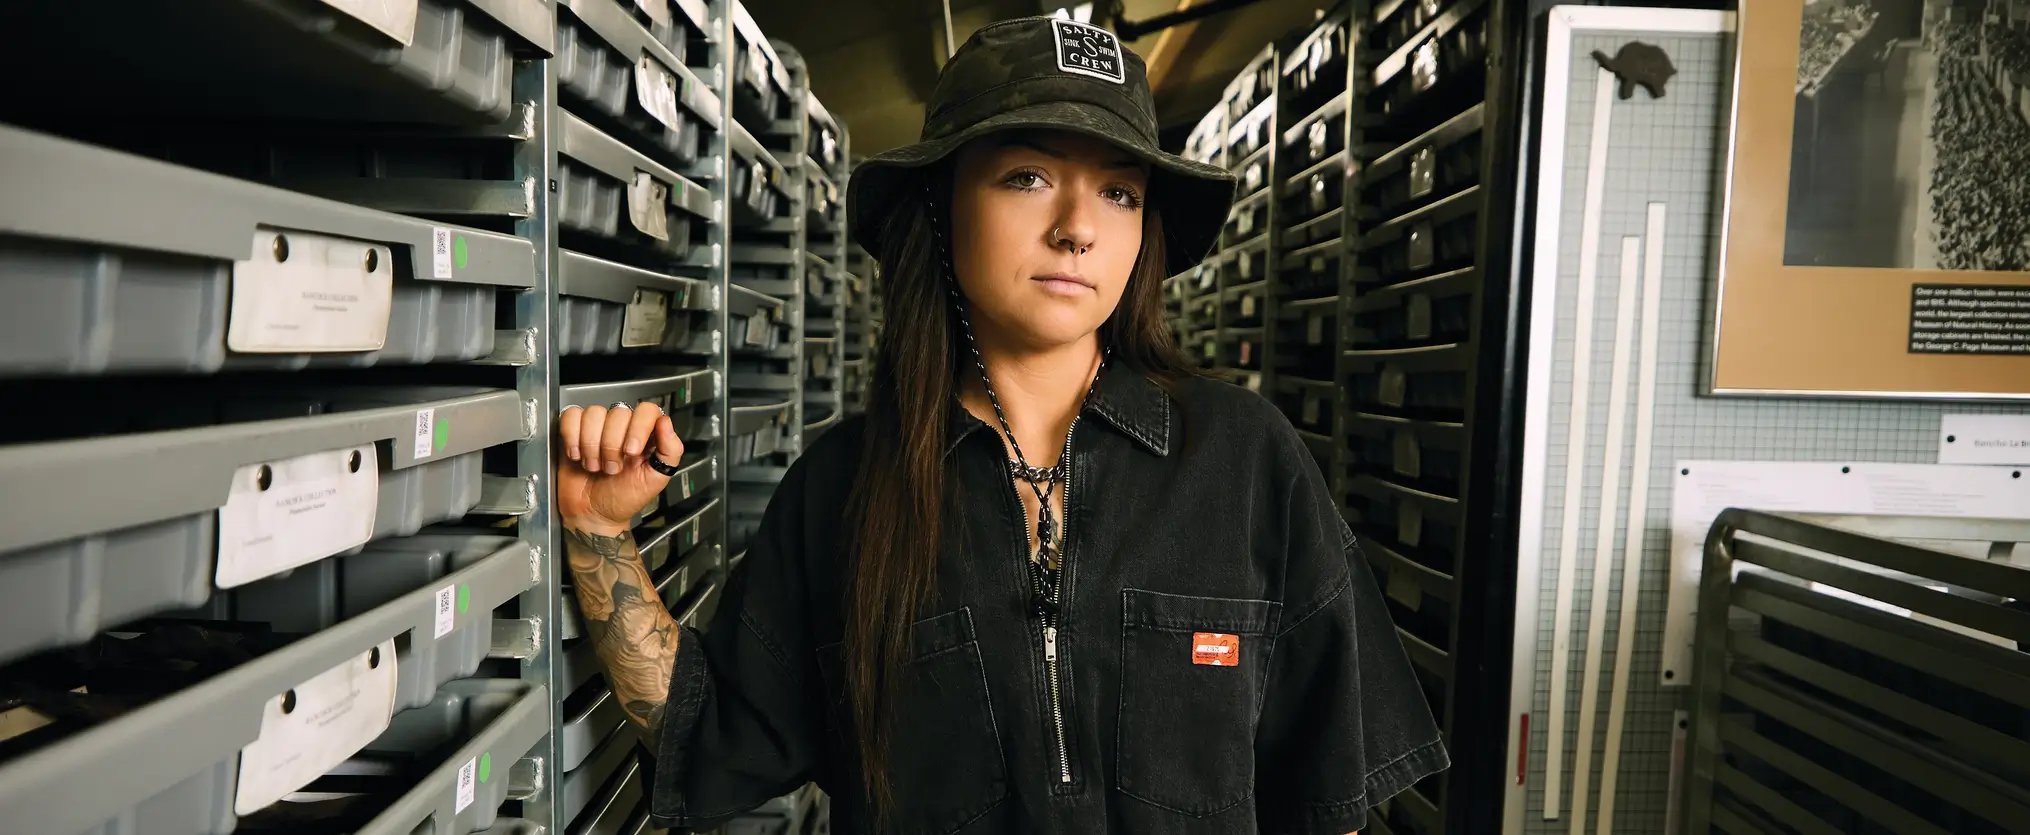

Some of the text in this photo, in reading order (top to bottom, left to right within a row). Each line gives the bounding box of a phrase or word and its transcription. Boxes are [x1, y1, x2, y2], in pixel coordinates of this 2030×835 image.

[1063, 26, 1111, 43] SALTY
[1064, 38, 1080, 47] SINK
[1083, 36, 1098, 57] S
[1099, 46, 1115, 57] SWIM
[1070, 53, 1112, 70] CREW
[1916, 287, 1933, 296] Over
[1934, 288, 1948, 296] one
[1949, 288, 1973, 297] million
[1997, 290, 2015, 298] were
[1915, 299, 1930, 307] and
[1947, 299, 1979, 309] Although
[1979, 300, 2016, 309] specimens
[1937, 310, 1949, 318] the
[1949, 310, 1973, 320] largest
[1974, 310, 2008, 319] collection
[1914, 320, 1943, 329] Museum
[1944, 320, 1952, 329] of
[1952, 321, 1978, 330] Natural
[2004, 322, 2014, 330] As
[1913, 332, 1940, 341] storage
[1941, 332, 1970, 340] cabinets
[1971, 333, 1984, 341] are
[2012, 333, 2024, 341] the
[1912, 342, 1925, 350] the
[1925, 342, 1952, 352] George
[1961, 343, 1980, 352] Page
[1981, 343, 2011, 351] Museum
[2011, 343, 2025, 351] and
